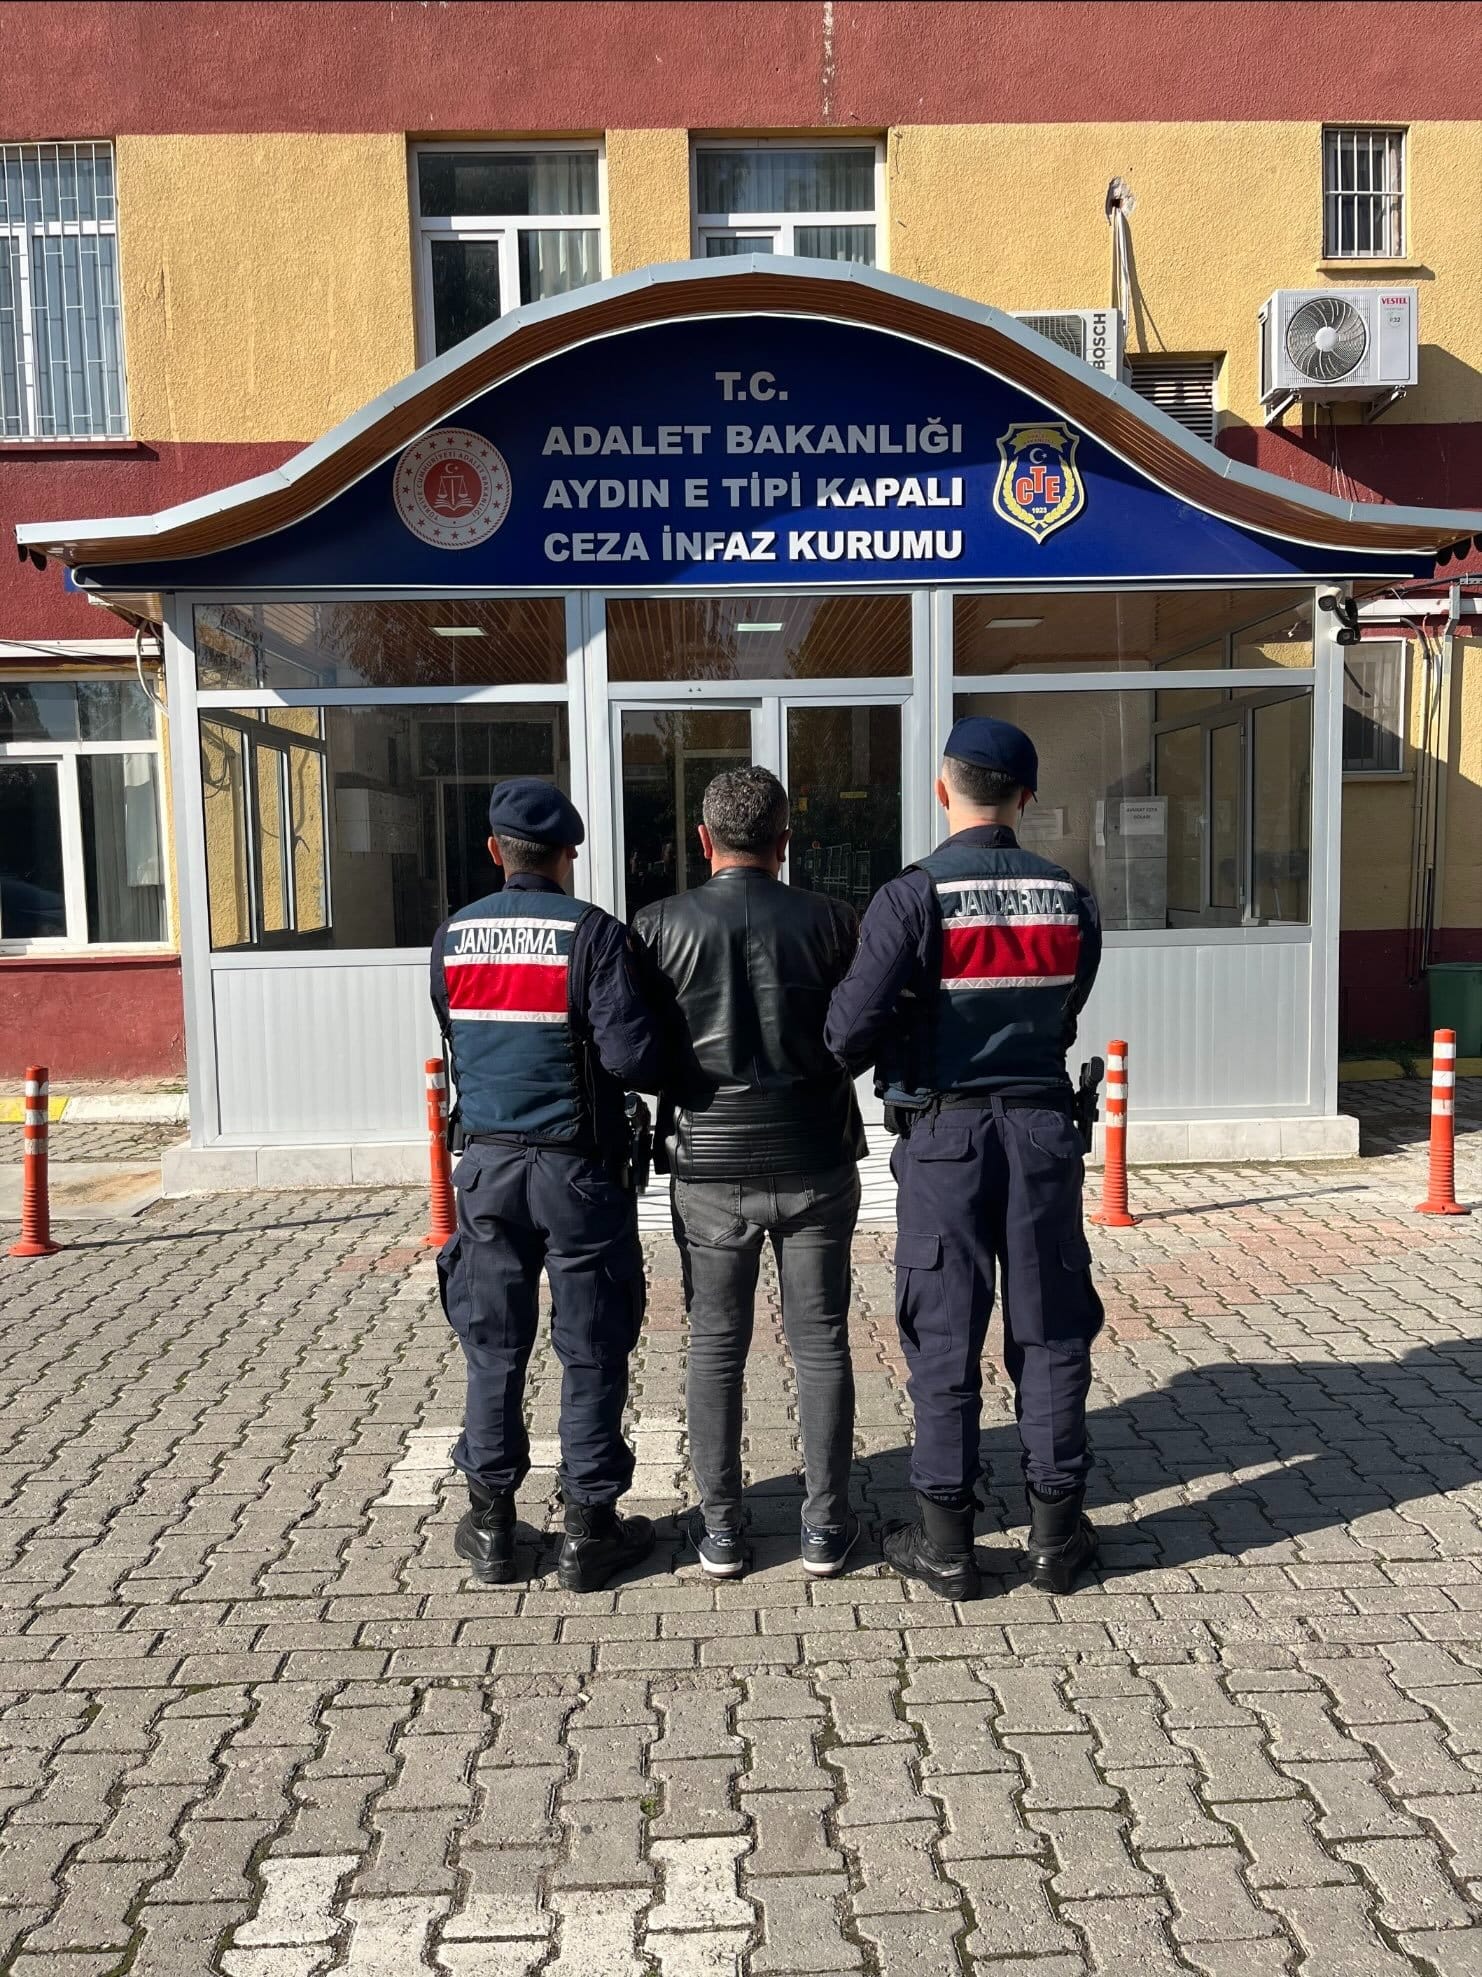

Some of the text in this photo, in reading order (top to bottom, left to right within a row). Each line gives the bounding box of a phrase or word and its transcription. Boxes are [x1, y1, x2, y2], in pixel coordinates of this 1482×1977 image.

[1381, 297, 1408, 305] VESTEL
[1093, 313, 1106, 370] BOSCH
[715, 371, 788, 401] T.C.
[541, 417, 962, 455] ADALET BAKANLIĞI
[543, 471, 963, 509] AYDIN E TİPİ KAPALI
[1015, 466, 1061, 505] CTE
[544, 525, 963, 562] CEZA İNFAZ KURUMU
[954, 889, 1067, 917] JANDARMA
[454, 927, 558, 954] JANDARMA
